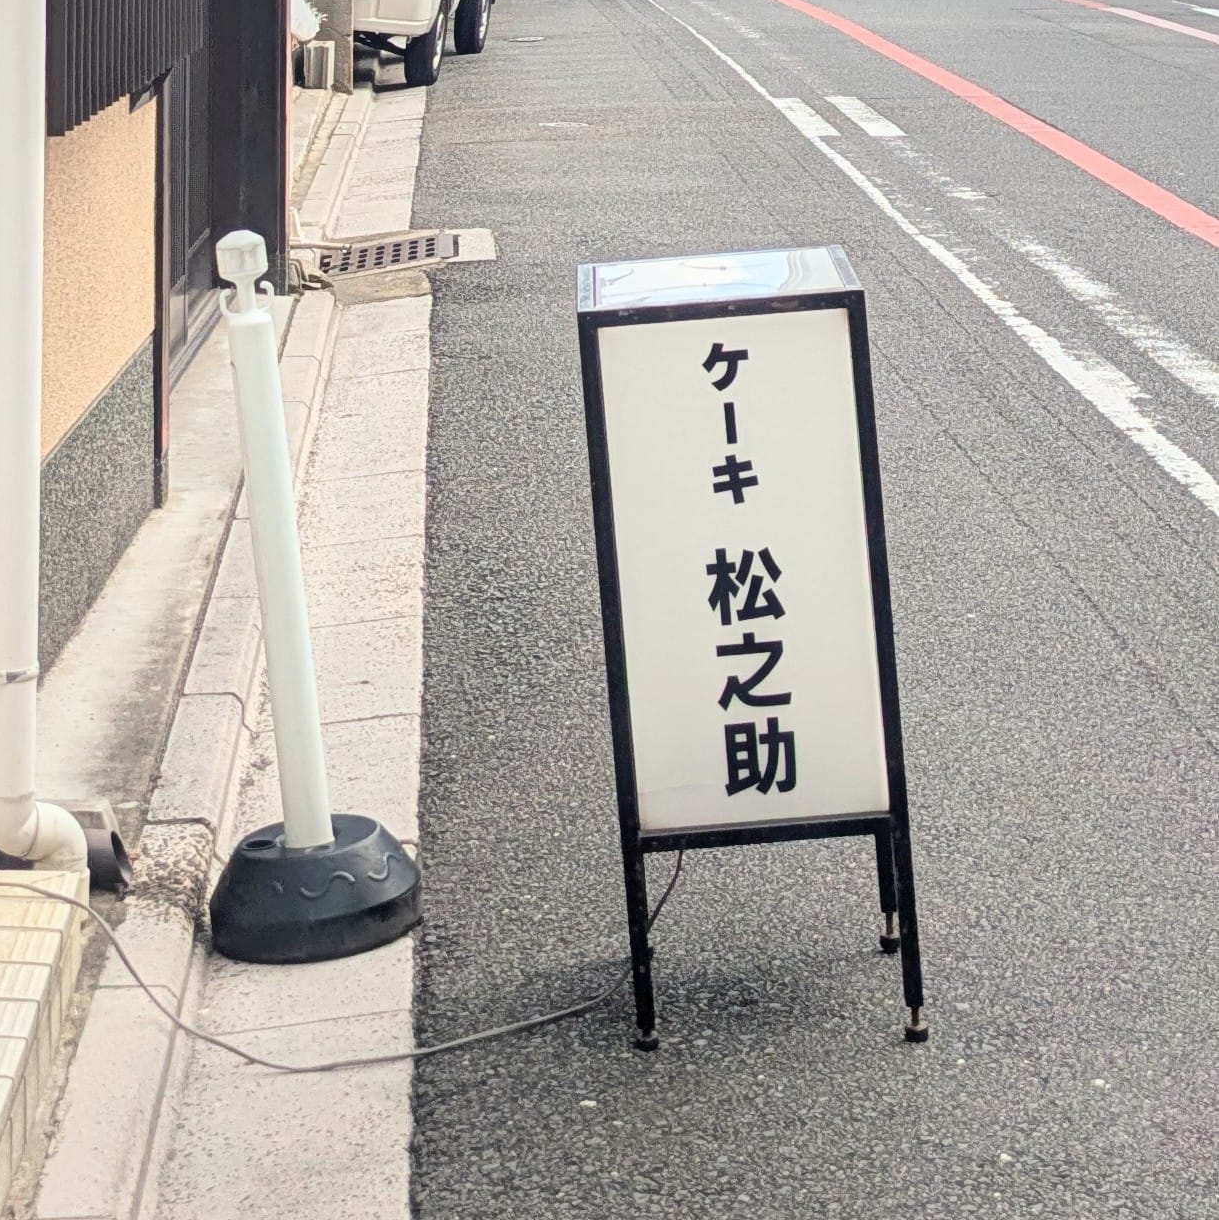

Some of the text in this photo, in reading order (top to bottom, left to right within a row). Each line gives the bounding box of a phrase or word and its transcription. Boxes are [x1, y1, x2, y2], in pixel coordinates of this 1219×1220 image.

[702, 342, 796, 796] ケーキ 松之助
